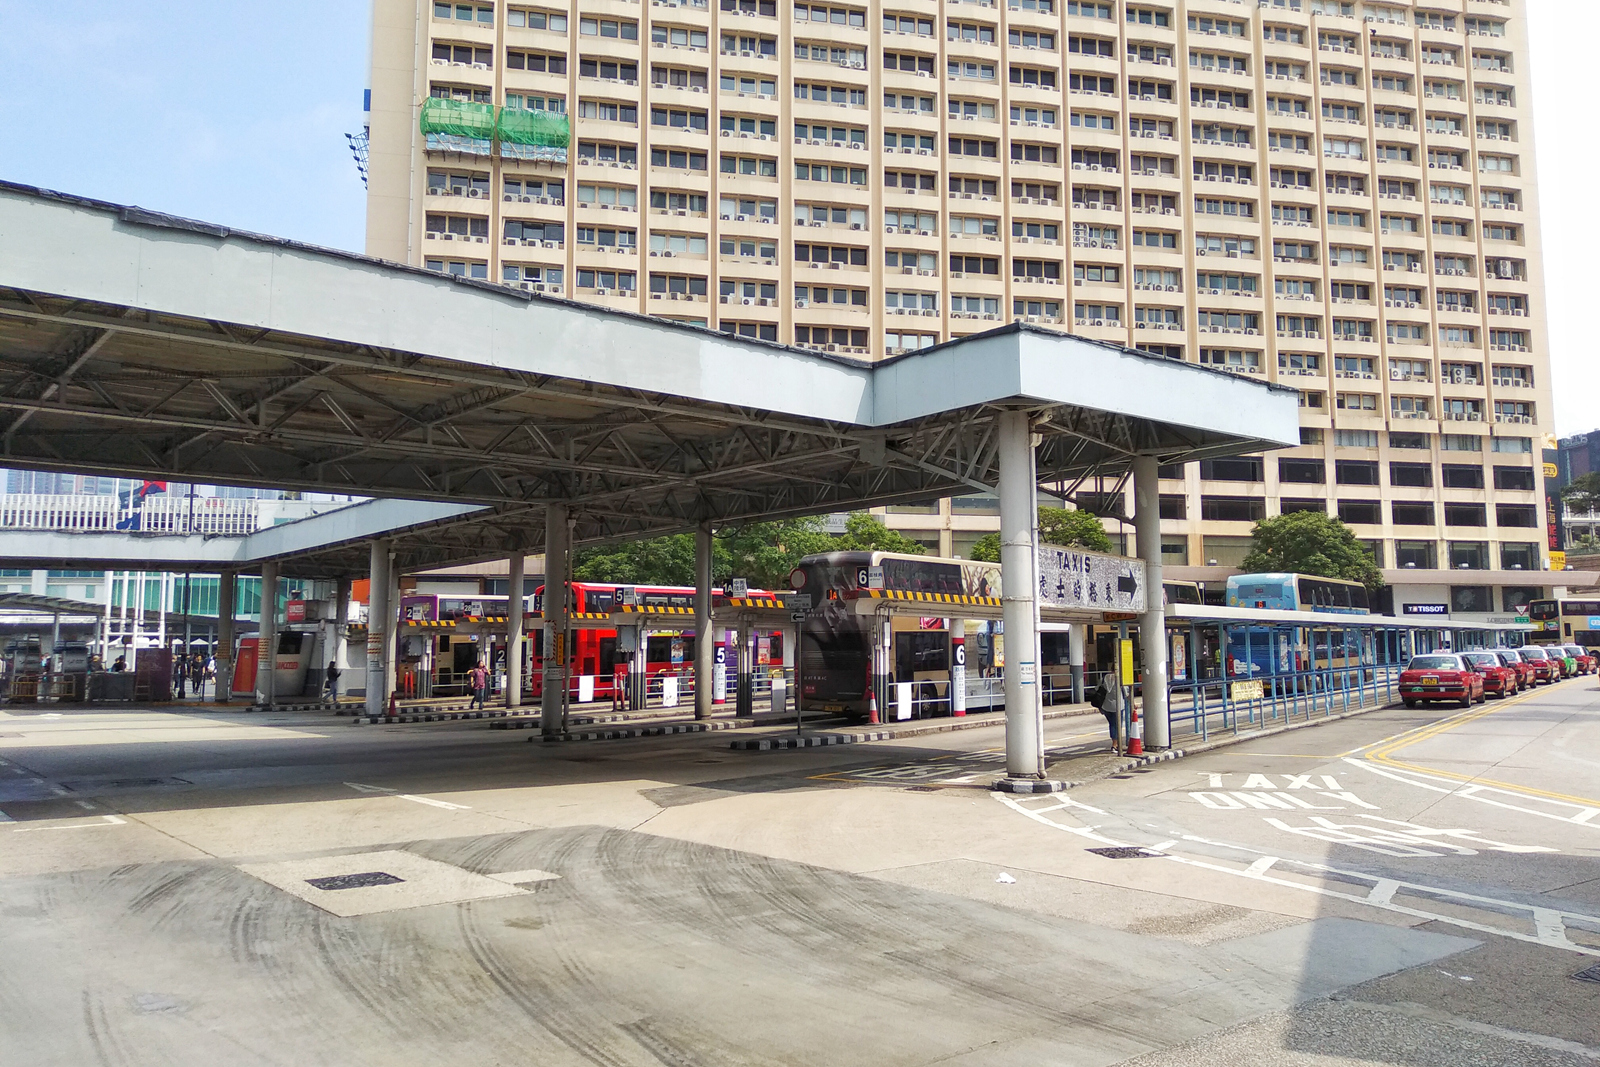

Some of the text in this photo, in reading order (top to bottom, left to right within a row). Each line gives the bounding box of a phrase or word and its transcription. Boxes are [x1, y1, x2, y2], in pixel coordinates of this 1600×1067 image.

[1056, 551, 1091, 573] TAXIS
[858, 569, 868, 585] 6
[616, 589, 623, 602] 5
[723, 582, 734, 593] 1A
[829, 589, 838, 600] 1A
[407, 608, 413, 618] 2
[497, 649, 505, 662] 2
[716, 647, 725, 663] 5
[956, 644, 965, 665] 6
[1197, 772, 1345, 789] TAXI
[1188, 791, 1382, 810] ONLY
